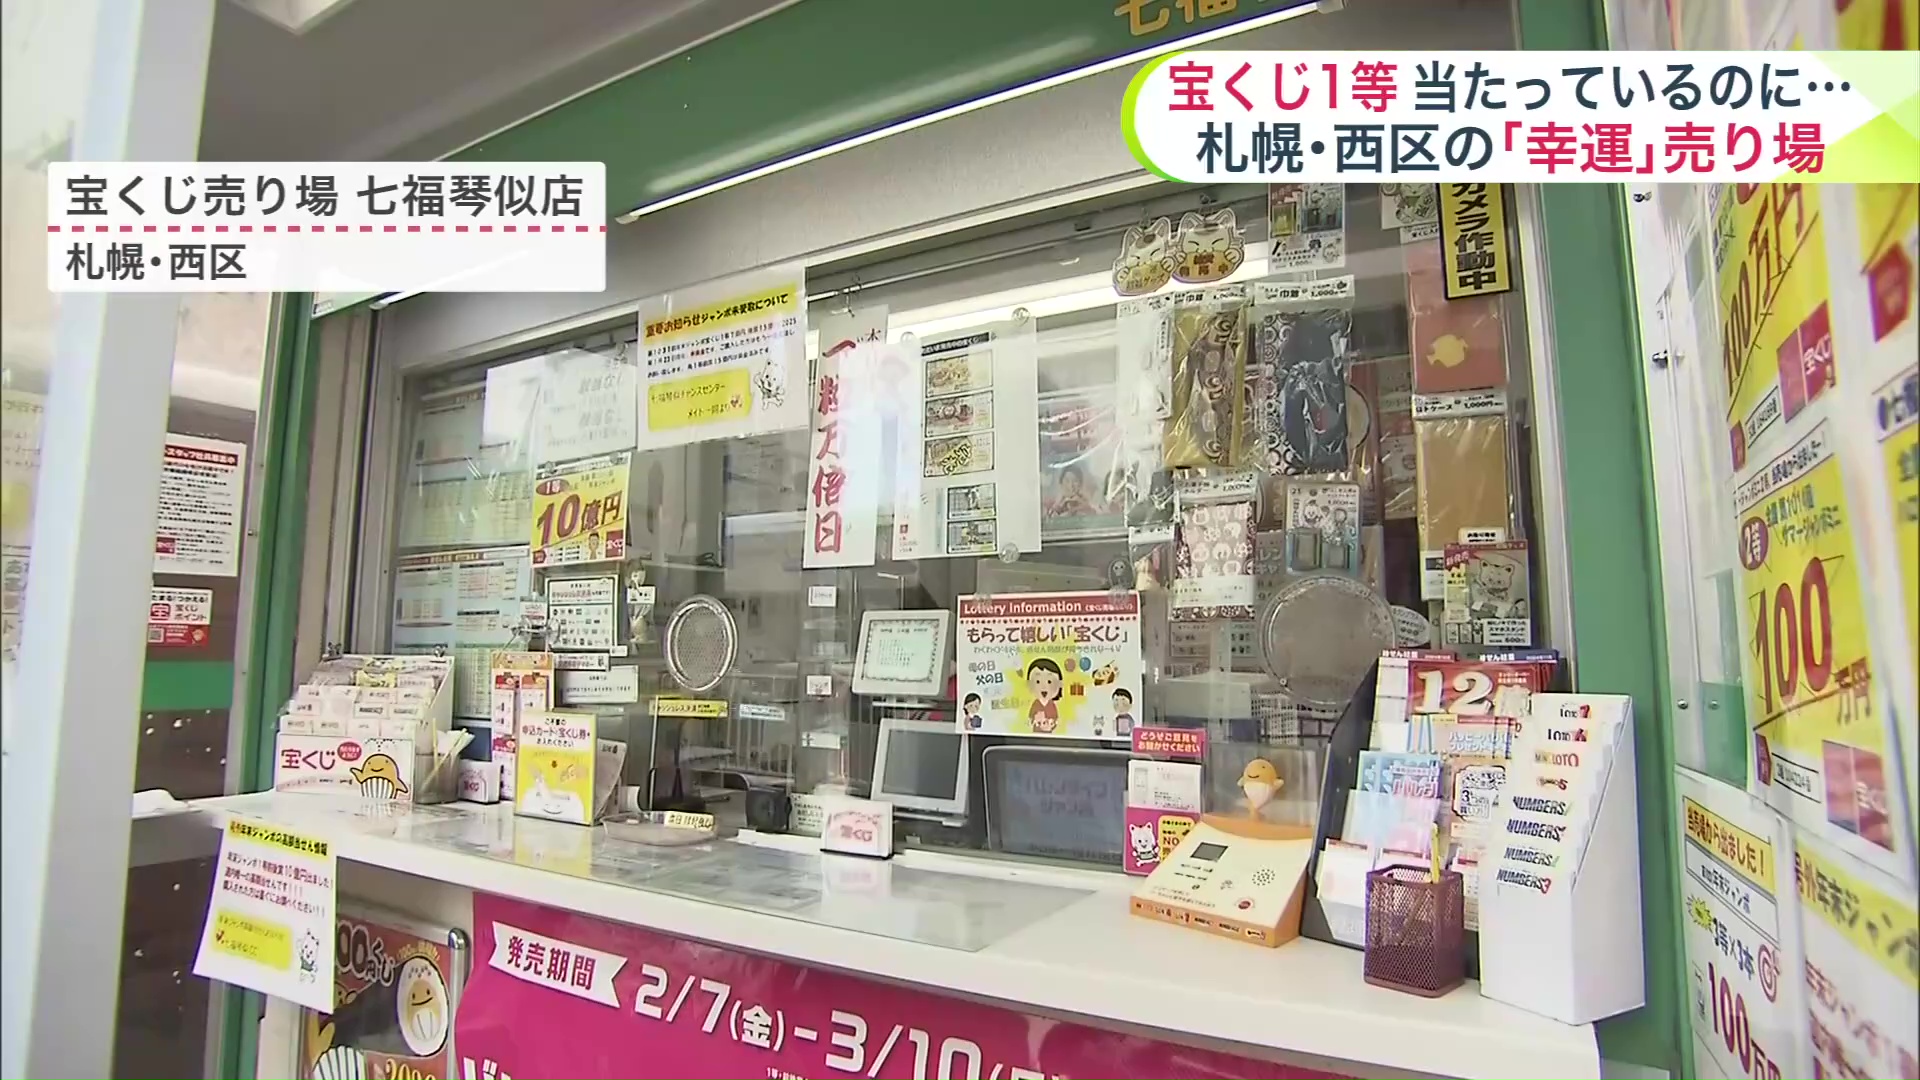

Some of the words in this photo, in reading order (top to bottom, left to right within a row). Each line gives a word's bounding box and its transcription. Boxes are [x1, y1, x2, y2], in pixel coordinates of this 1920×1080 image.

[537, 490, 623, 546] 10億円
[174, 604, 199, 612] 宝くじ
[963, 602, 1006, 616] Lottery
[1009, 600, 1082, 613] Information
[174, 613, 207, 622] ポイント
[966, 625, 1129, 644] もらって嬉しい「宝くじ」
[1755, 556, 1832, 715] 100
[968, 661, 996, 673] 母の日
[975, 672, 1004, 686] 父の日
[1140, 731, 1198, 743] どうぞご意見を
[1138, 742, 1201, 753] お聞かせください
[281, 748, 337, 770] 宝くじ
[506, 933, 597, 992] 発売期間
